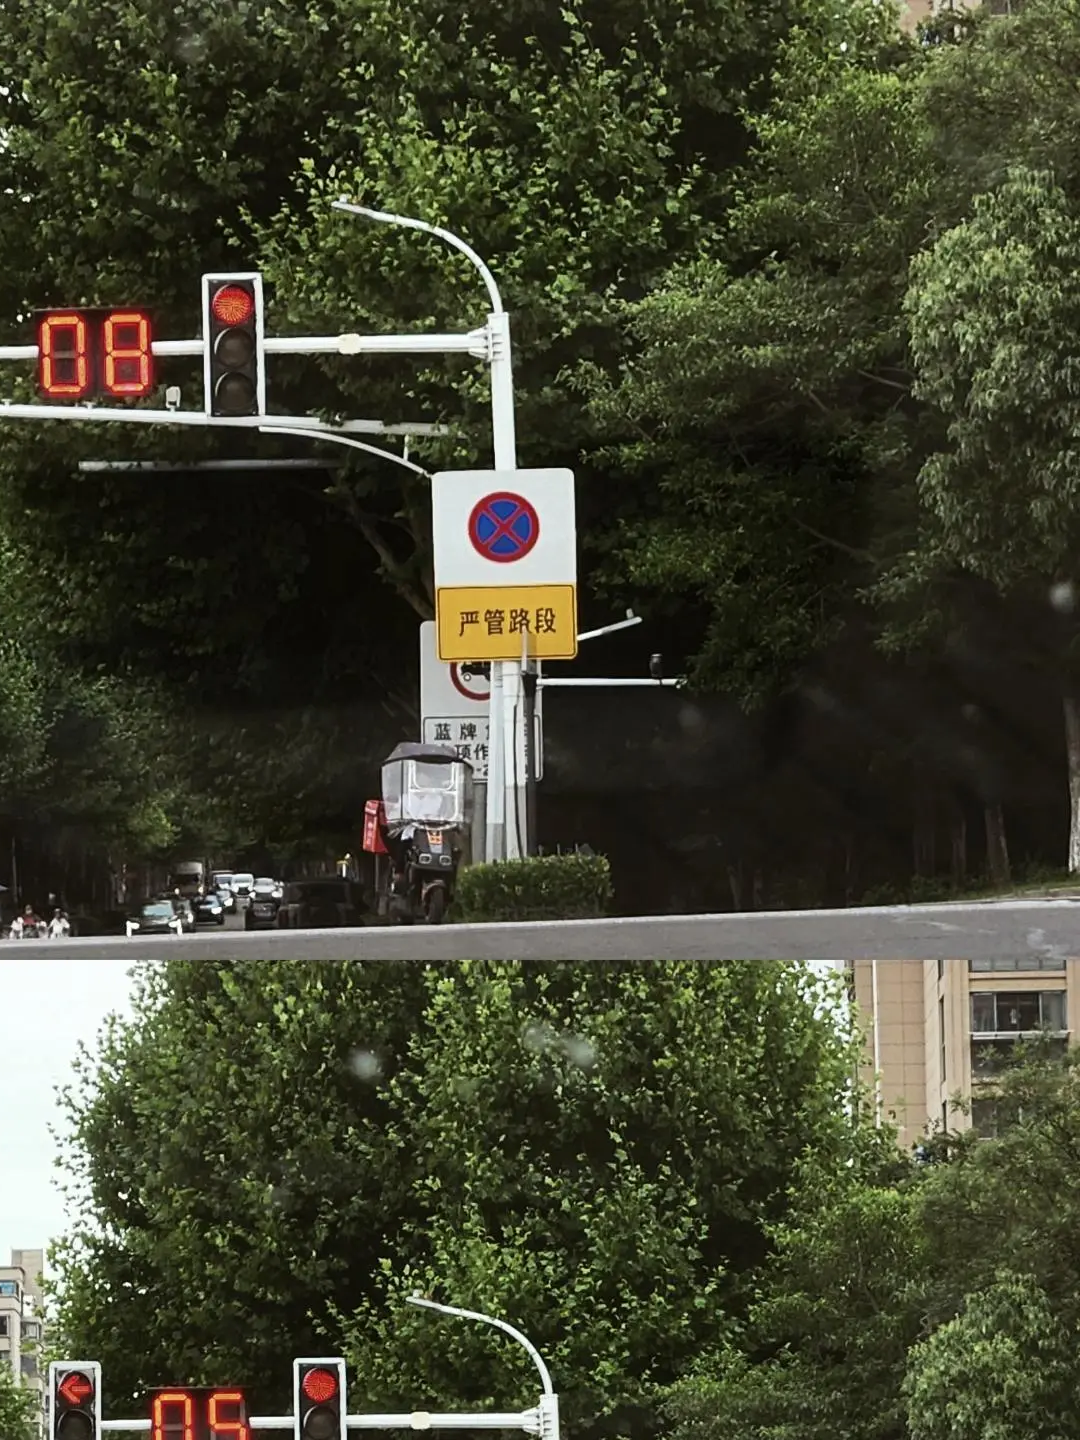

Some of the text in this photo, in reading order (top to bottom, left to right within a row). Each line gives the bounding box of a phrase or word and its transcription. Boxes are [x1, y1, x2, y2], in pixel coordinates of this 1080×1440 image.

[39, 311, 149, 394] 08
[459, 607, 557, 636] 严管路段
[434, 722, 489, 741] 蓝牌
